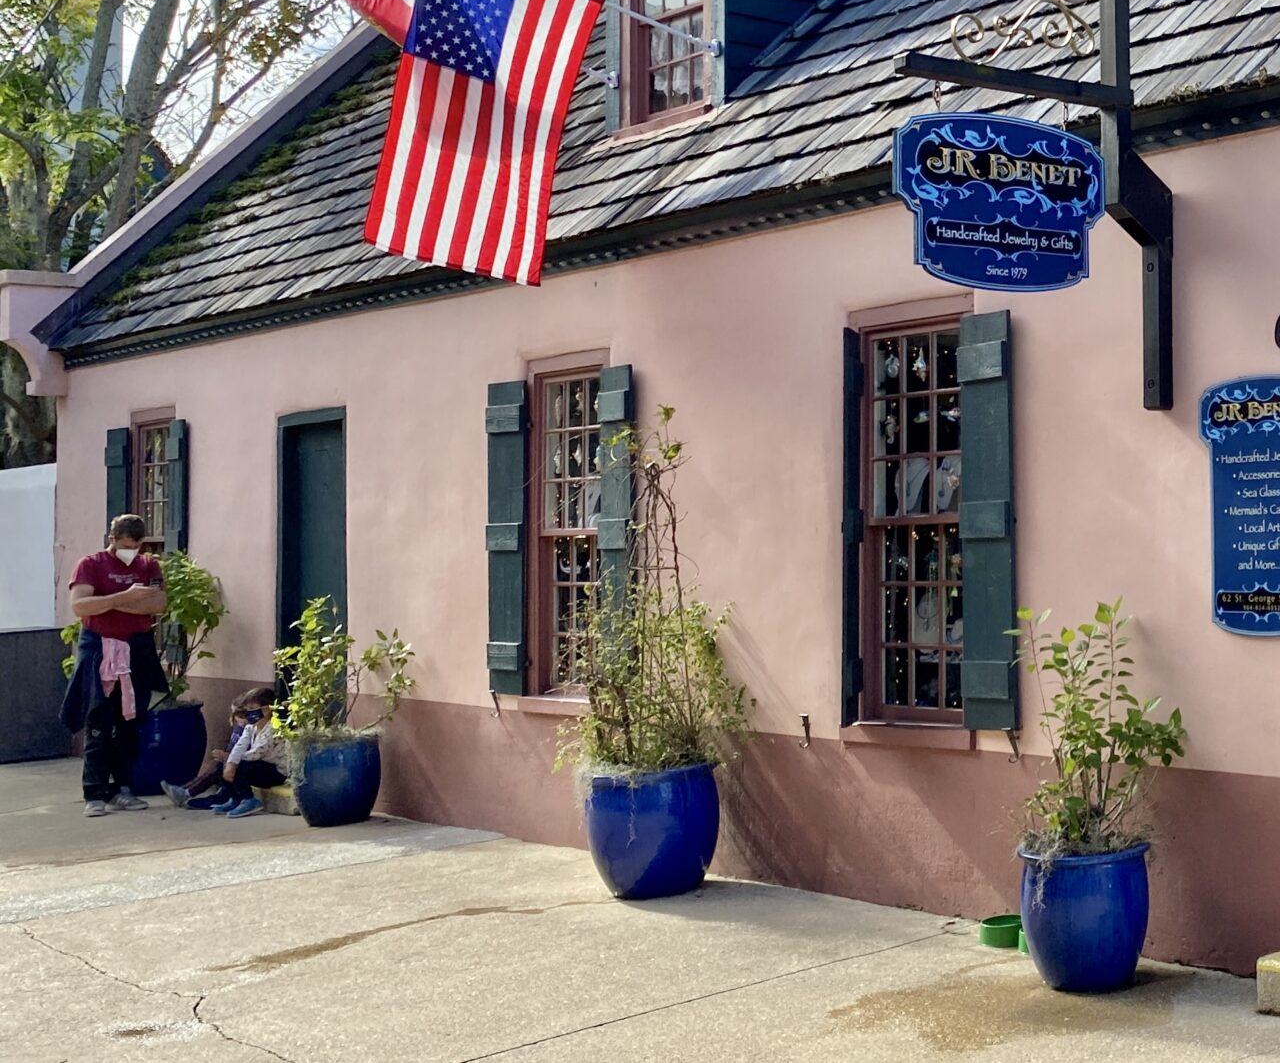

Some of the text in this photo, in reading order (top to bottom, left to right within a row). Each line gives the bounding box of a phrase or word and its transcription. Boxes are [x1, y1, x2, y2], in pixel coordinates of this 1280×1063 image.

[936, 224, 1074, 252] Handcrafted Jewelry & Gifts
[985, 265, 1028, 279] Since 1979
[1221, 448, 1270, 464] Handcrafted
[1242, 484, 1280, 498] Sea Glass
[1229, 502, 1268, 516] Mermaid's
[1244, 519, 1280, 533] Local Art
[1238, 541, 1266, 556] Unique
[1238, 556, 1253, 570] and
[1222, 594, 1232, 603] 62
[1248, 594, 1276, 605] George
